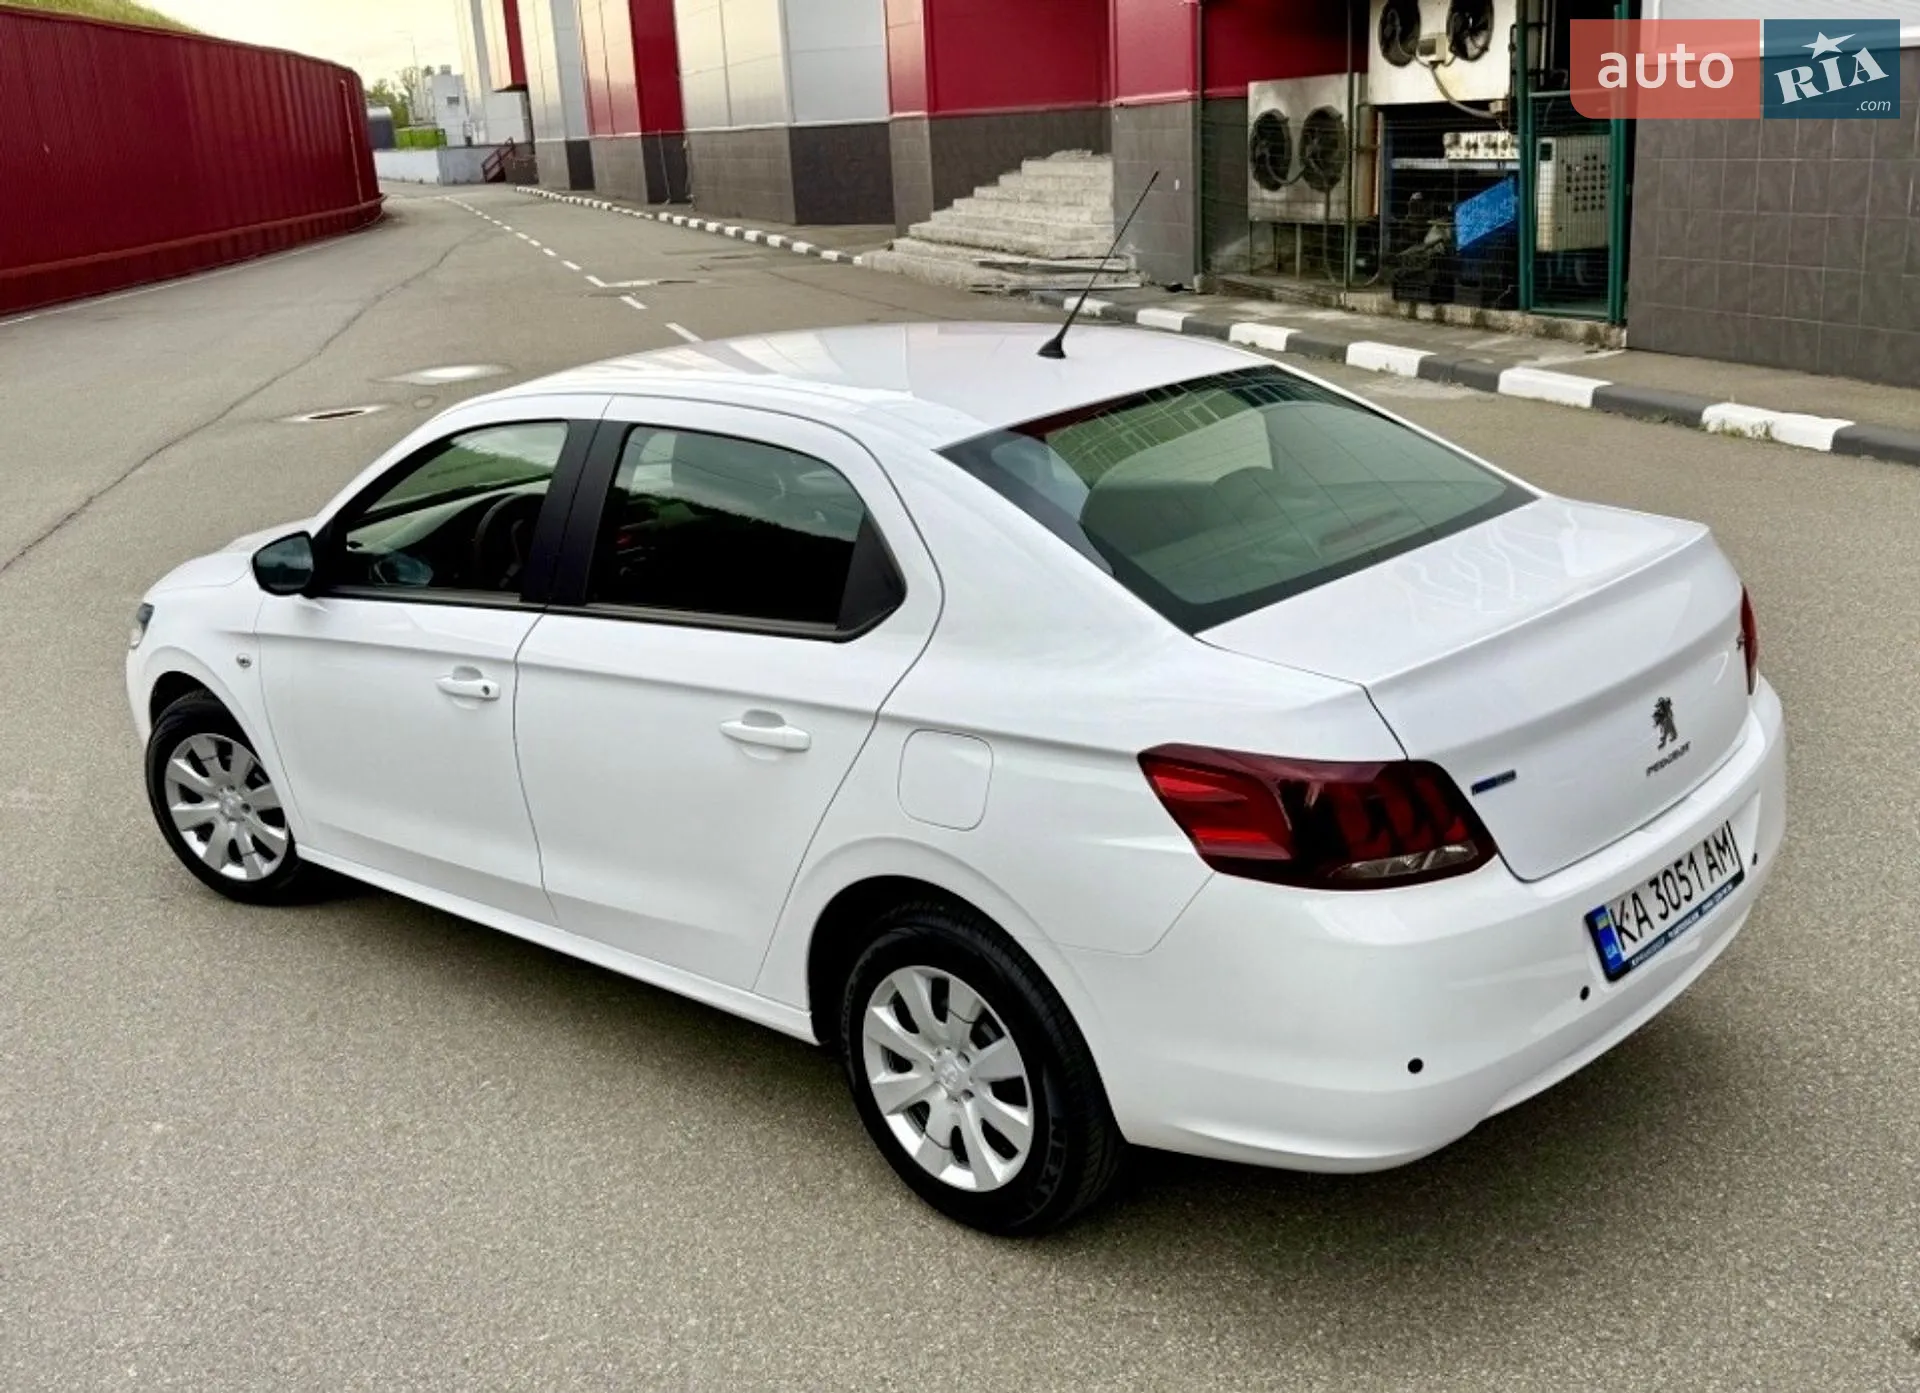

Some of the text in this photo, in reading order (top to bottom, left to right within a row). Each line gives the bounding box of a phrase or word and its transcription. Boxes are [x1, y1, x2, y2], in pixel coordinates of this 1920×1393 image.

[1609, 891, 1655, 951] KA
[1648, 851, 1705, 920] 3051
[1703, 829, 1735, 884] AM
